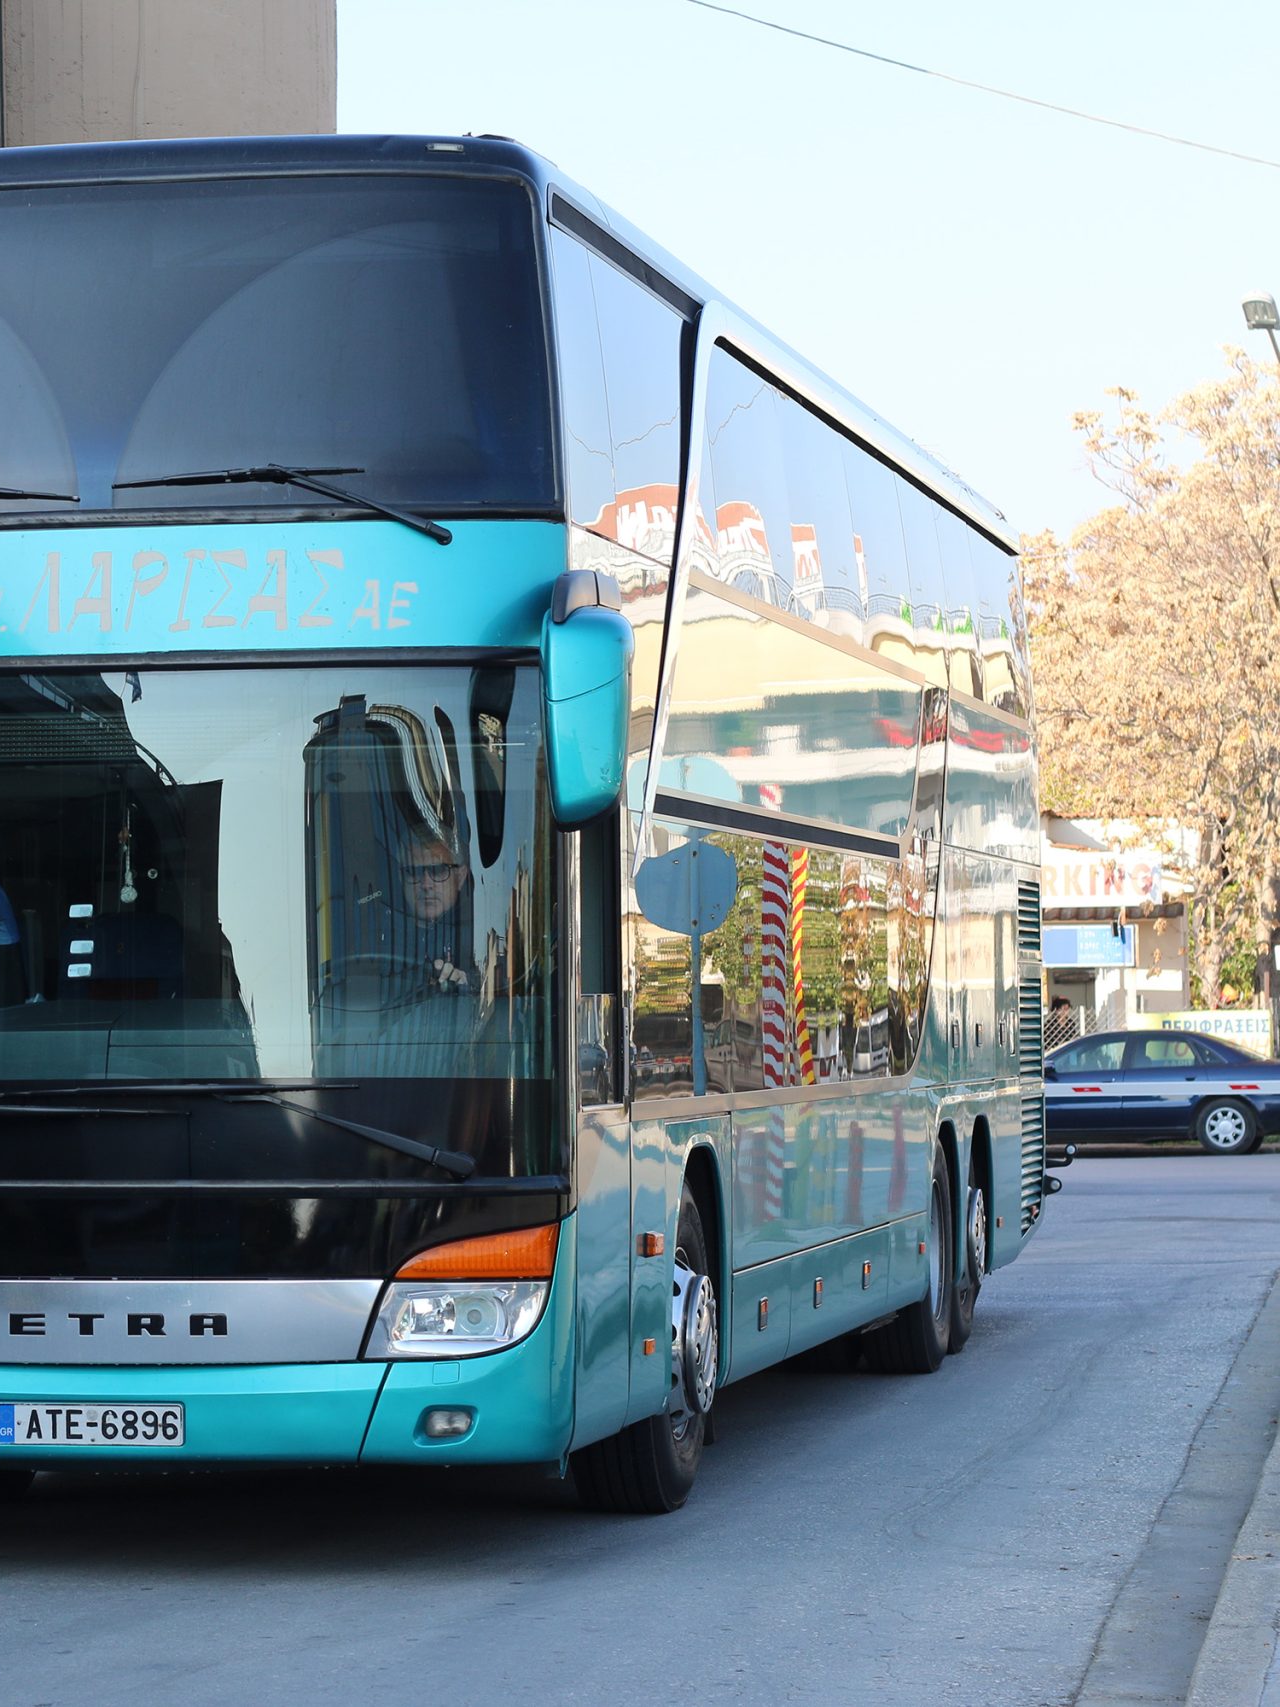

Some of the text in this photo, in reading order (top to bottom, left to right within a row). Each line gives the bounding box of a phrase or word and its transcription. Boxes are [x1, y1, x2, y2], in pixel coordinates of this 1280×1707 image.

[19, 548, 346, 633] ΛΑΡΙΣΑΣ
[347, 579, 418, 631] ΑΕ
[1161, 1018, 1269, 1034] ΠΕΡΙΦΡΑΞΕΙΣ
[0, 1427, 13, 1437] GR
[26, 1409, 179, 1441] ATE-6896
